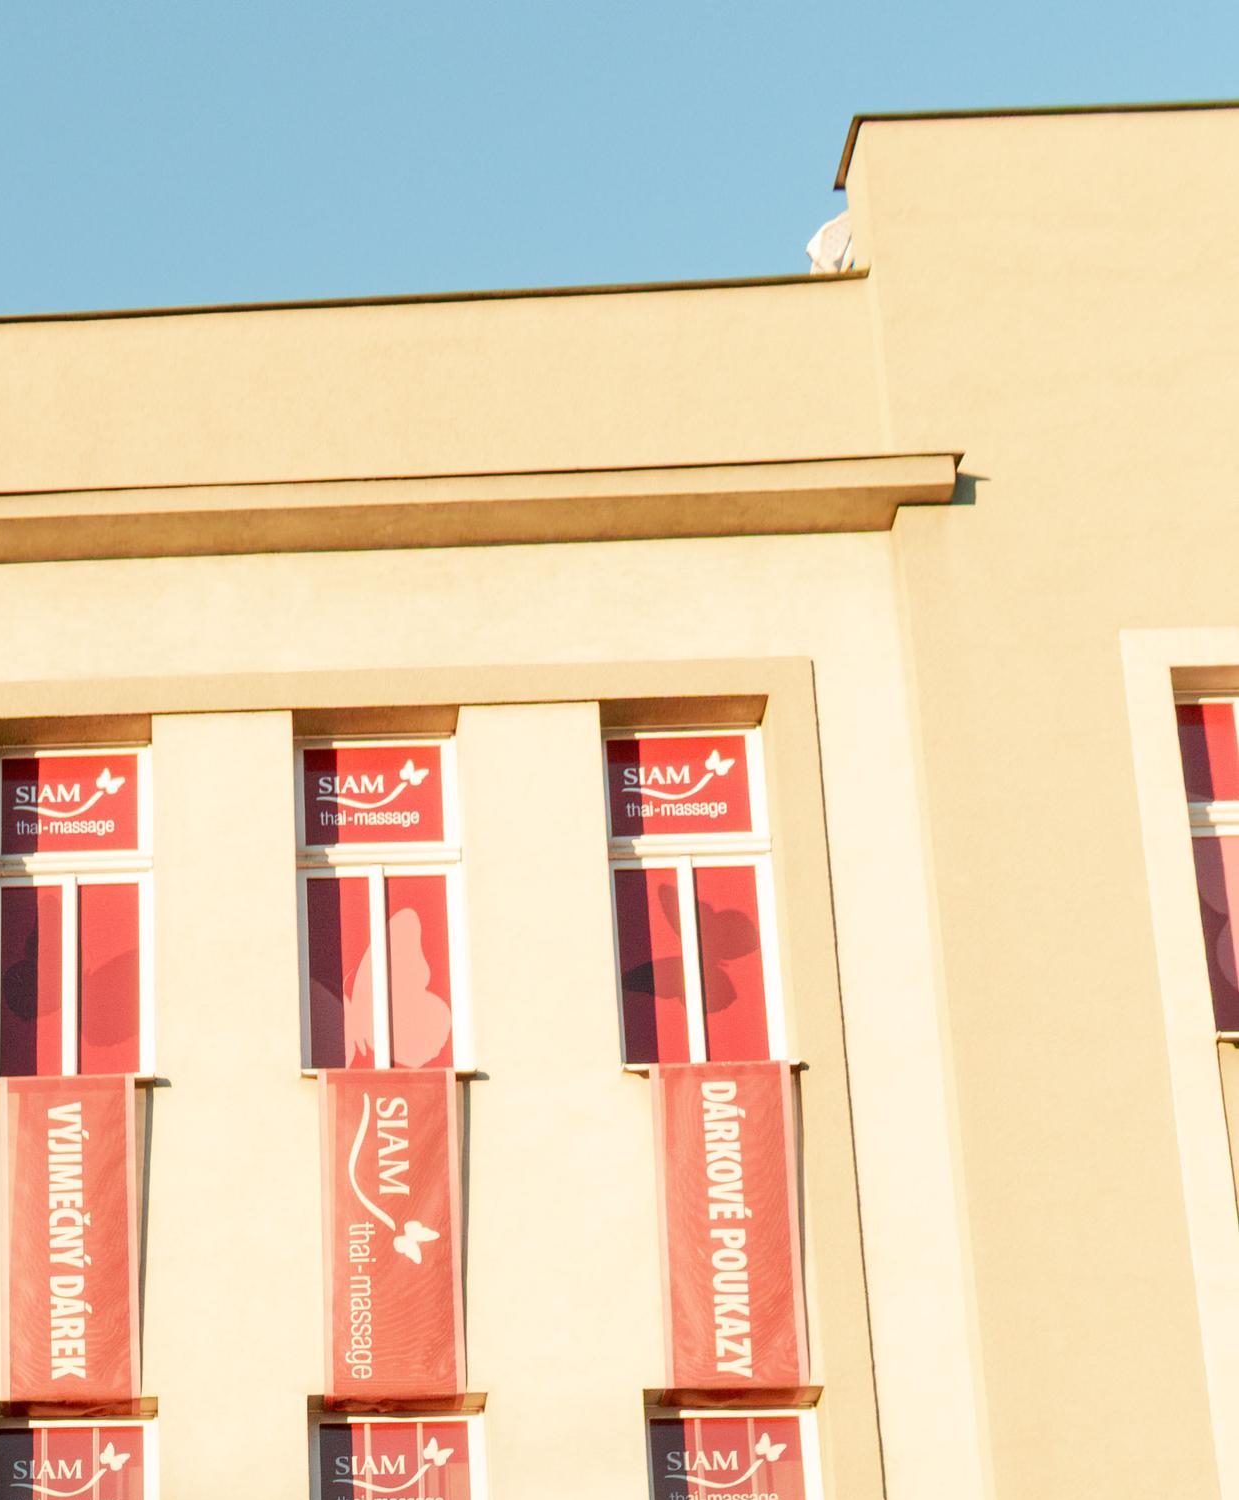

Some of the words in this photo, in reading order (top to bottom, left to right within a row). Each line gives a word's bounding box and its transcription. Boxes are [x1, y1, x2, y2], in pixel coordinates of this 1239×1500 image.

[317, 774, 385, 794] SIAM
[623, 765, 691, 786] SIAM
[15, 783, 81, 804] SIAM
[319, 809, 420, 828] thai-massage
[626, 799, 728, 818] thai-massage
[16, 818, 115, 836] thai-massage
[376, 1096, 411, 1196] SIAM
[700, 1079, 752, 1221] DÁRKOVÉ
[47, 1101, 92, 1266] VÝJIMEČNÝ
[345, 1221, 377, 1380] thai-massage
[710, 1229, 753, 1378] POUKAZY
[49, 1275, 92, 1380] DÁREK
[12, 1459, 83, 1480] SIAM
[335, 1455, 406, 1476] SIAM
[666, 1450, 739, 1471] SIAM
